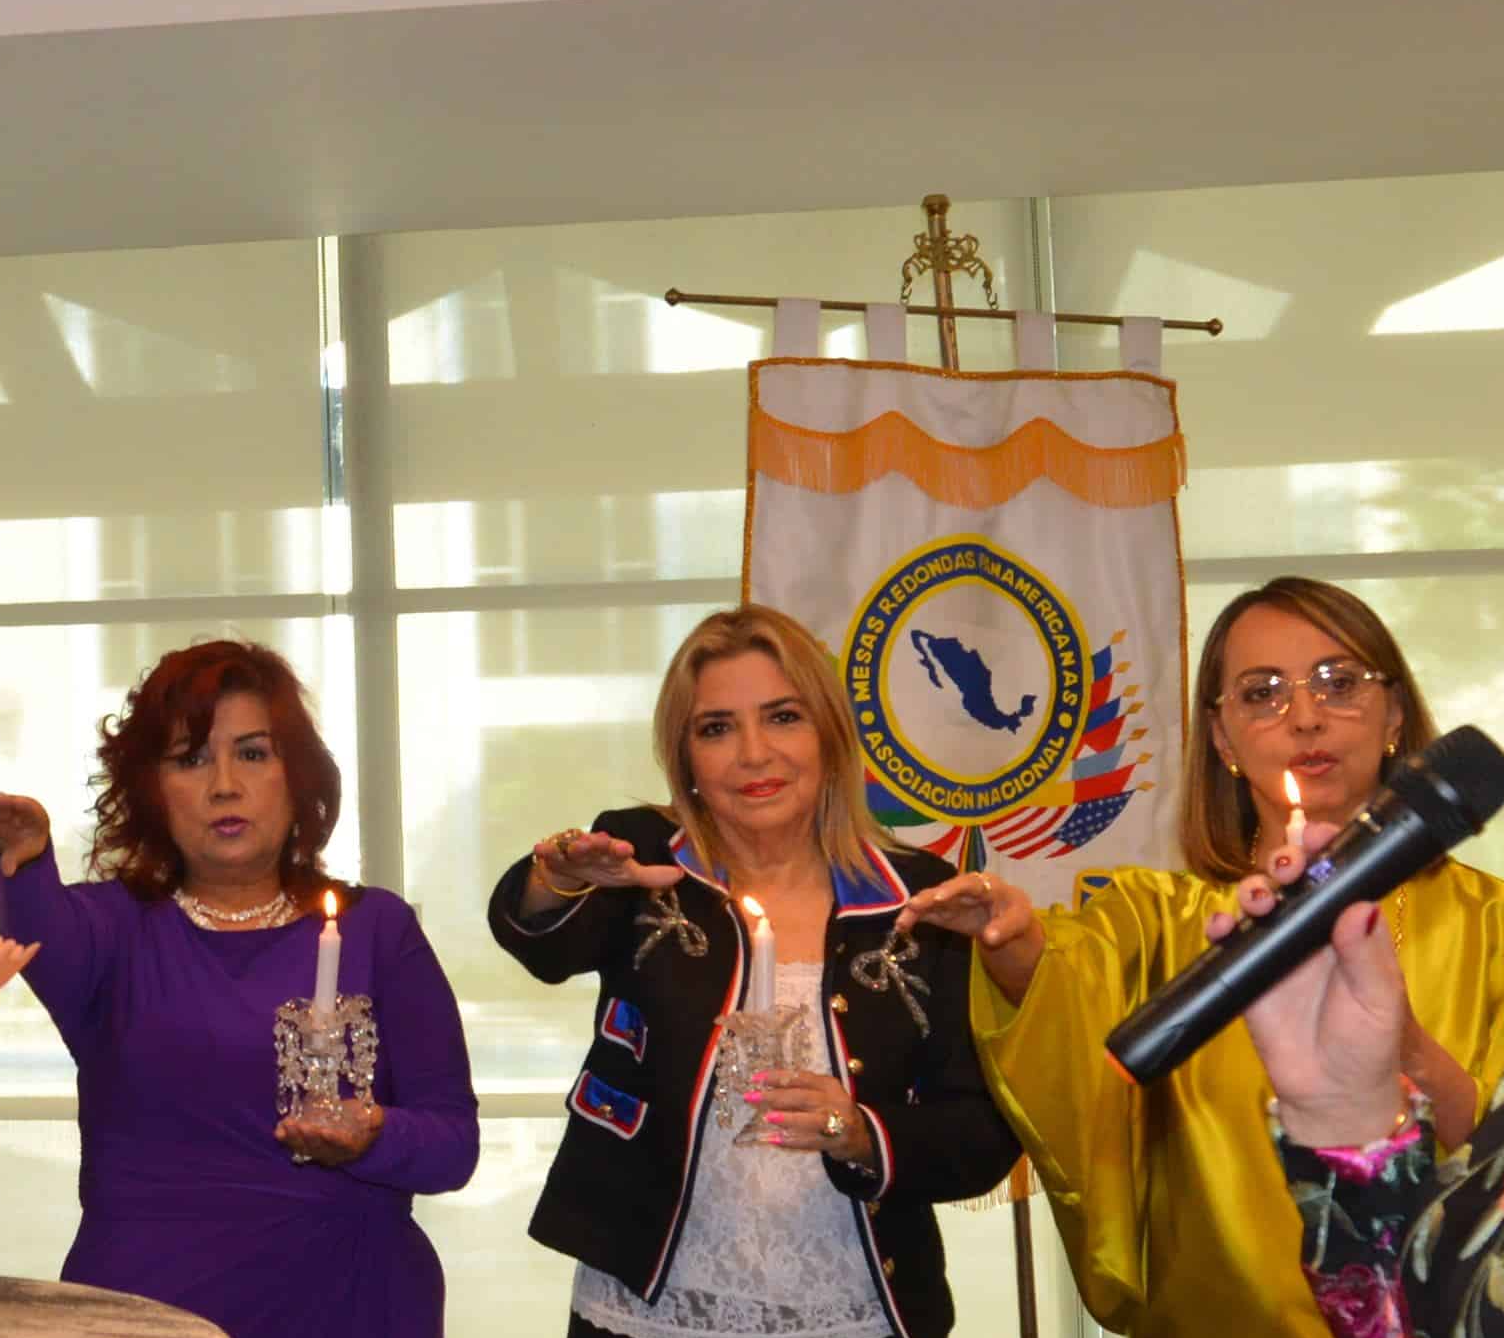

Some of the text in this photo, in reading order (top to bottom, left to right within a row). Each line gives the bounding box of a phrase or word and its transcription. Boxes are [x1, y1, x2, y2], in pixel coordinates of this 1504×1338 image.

[852, 616, 885, 702] MESAS
[879, 550, 977, 615] REDONDAS
[865, 731, 1065, 810] ASOCIACIÓN NACIONAL
